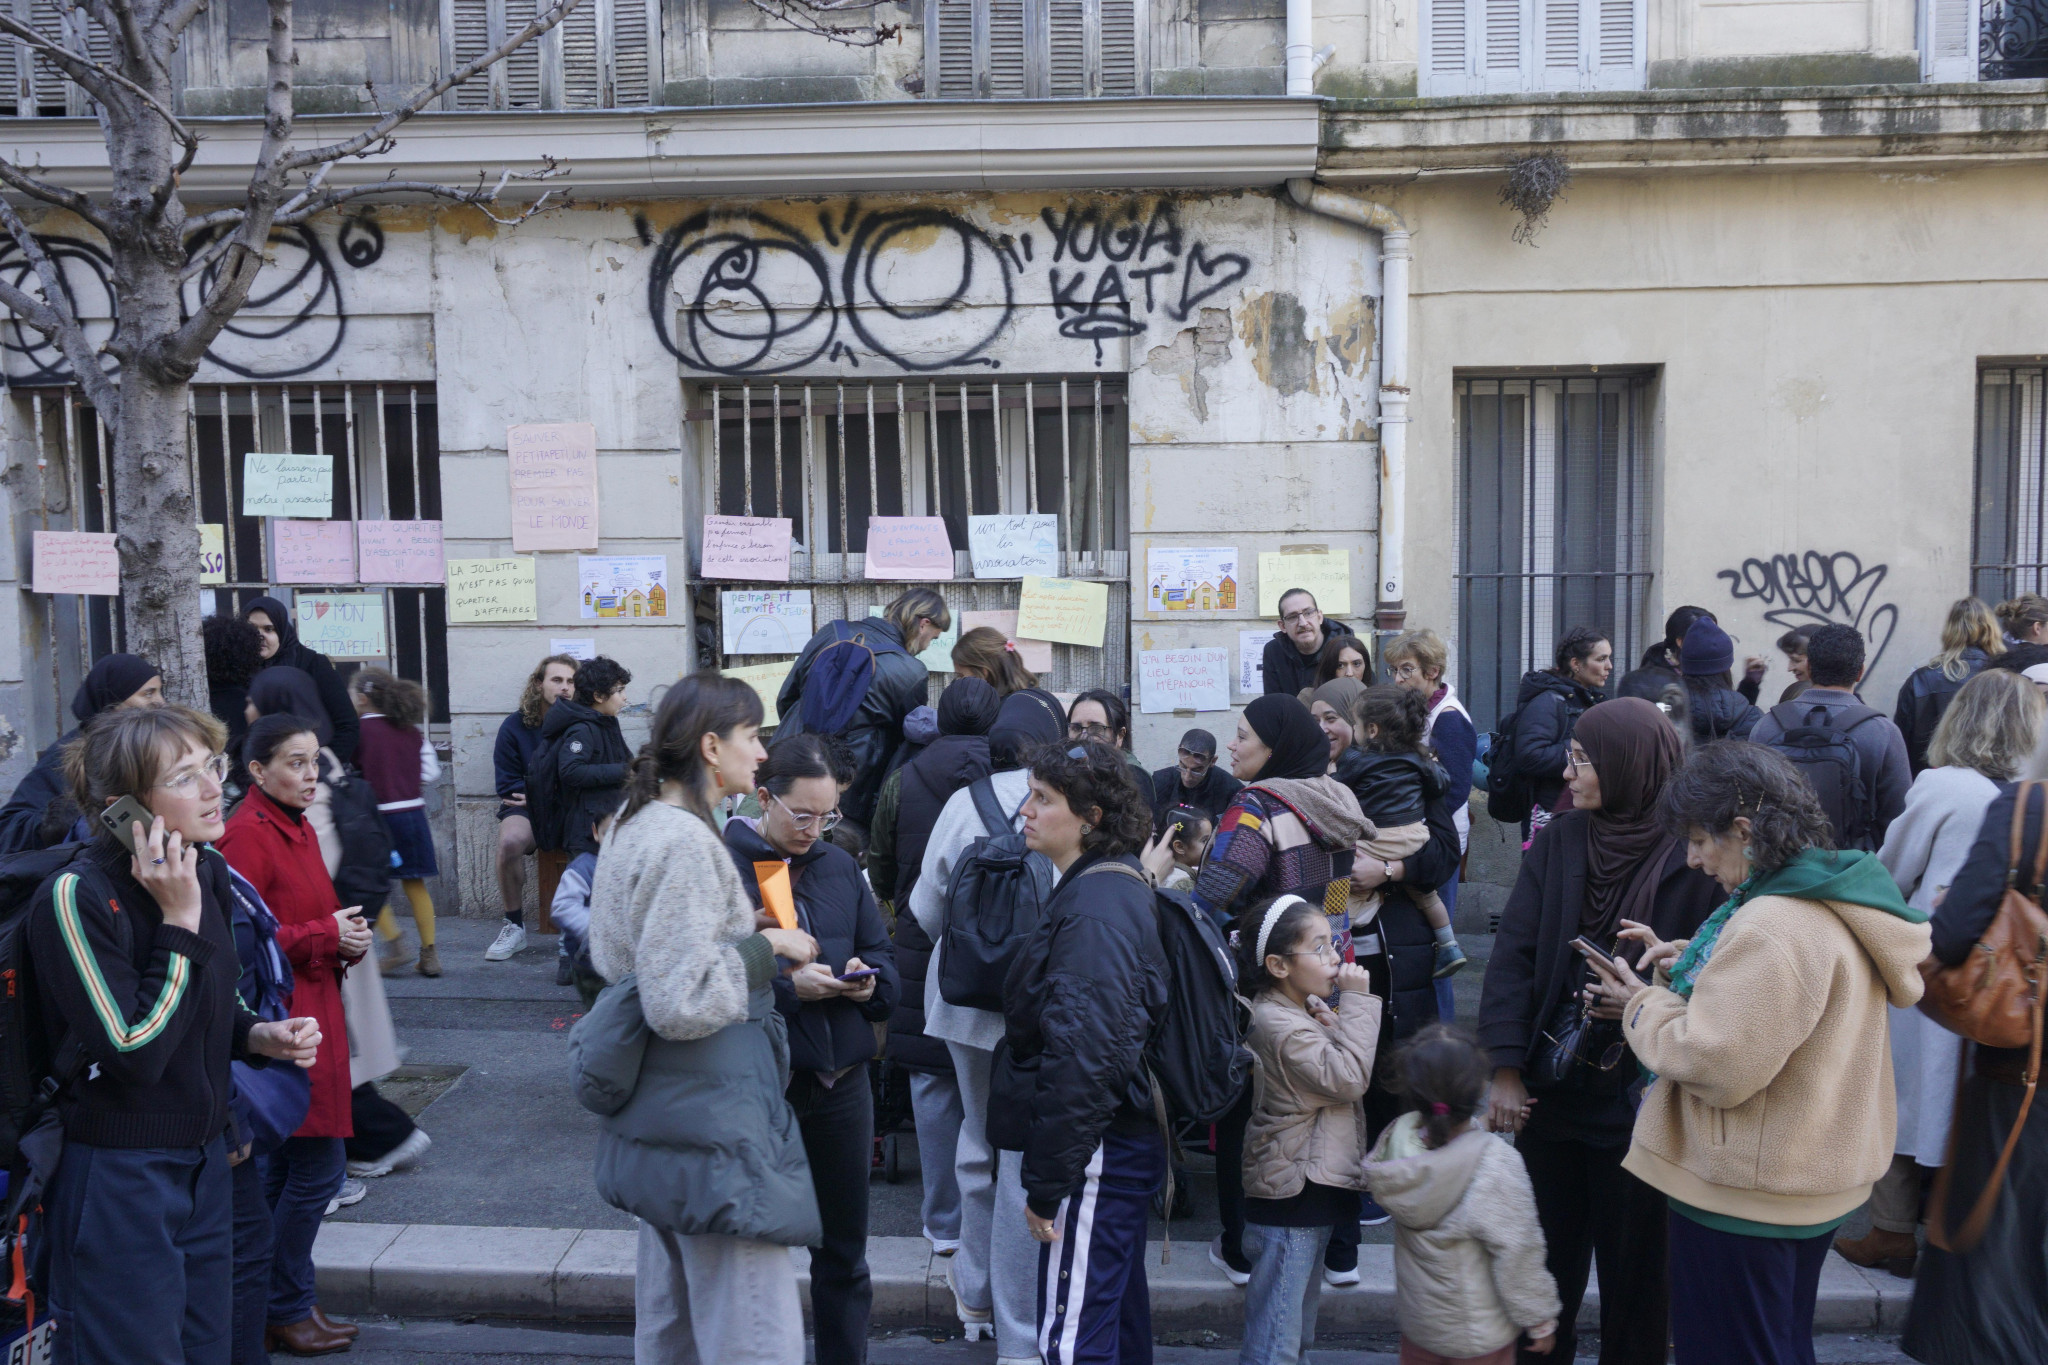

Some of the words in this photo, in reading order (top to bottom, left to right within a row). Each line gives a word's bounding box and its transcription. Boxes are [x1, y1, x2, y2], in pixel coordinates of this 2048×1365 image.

[1041, 200, 1183, 263] YOGA
[1048, 261, 1176, 320] KAT
[512, 431, 560, 446] SAUVER
[249, 457, 270, 474] Ne
[566, 467, 586, 477] PAS
[516, 495, 546, 507] POUR
[551, 496, 591, 507] SAUVER
[366, 523, 384, 533] UN
[529, 515, 544, 529] LE
[551, 515, 590, 530] MONDE
[871, 524, 888, 534] PAS
[1029, 520, 1057, 541] pour
[995, 533, 1014, 550] les
[450, 566, 464, 577] LA
[458, 578, 487, 591] N'EST
[488, 579, 508, 588] PAS
[512, 577, 536, 587] QU'UN
[456, 595, 499, 608] QUARTIER
[333, 602, 366, 623] MON
[782, 607, 809, 617] JEUX
[320, 624, 353, 640] ASSO
[1141, 655, 1161, 665] J'AI
[1165, 653, 1202, 664] BESOIN
[1207, 651, 1228, 663] D'UN
[1146, 668, 1171, 678] LIEU
[1182, 666, 1208, 676] POUR
[1179, 691, 1192, 706] !!!
